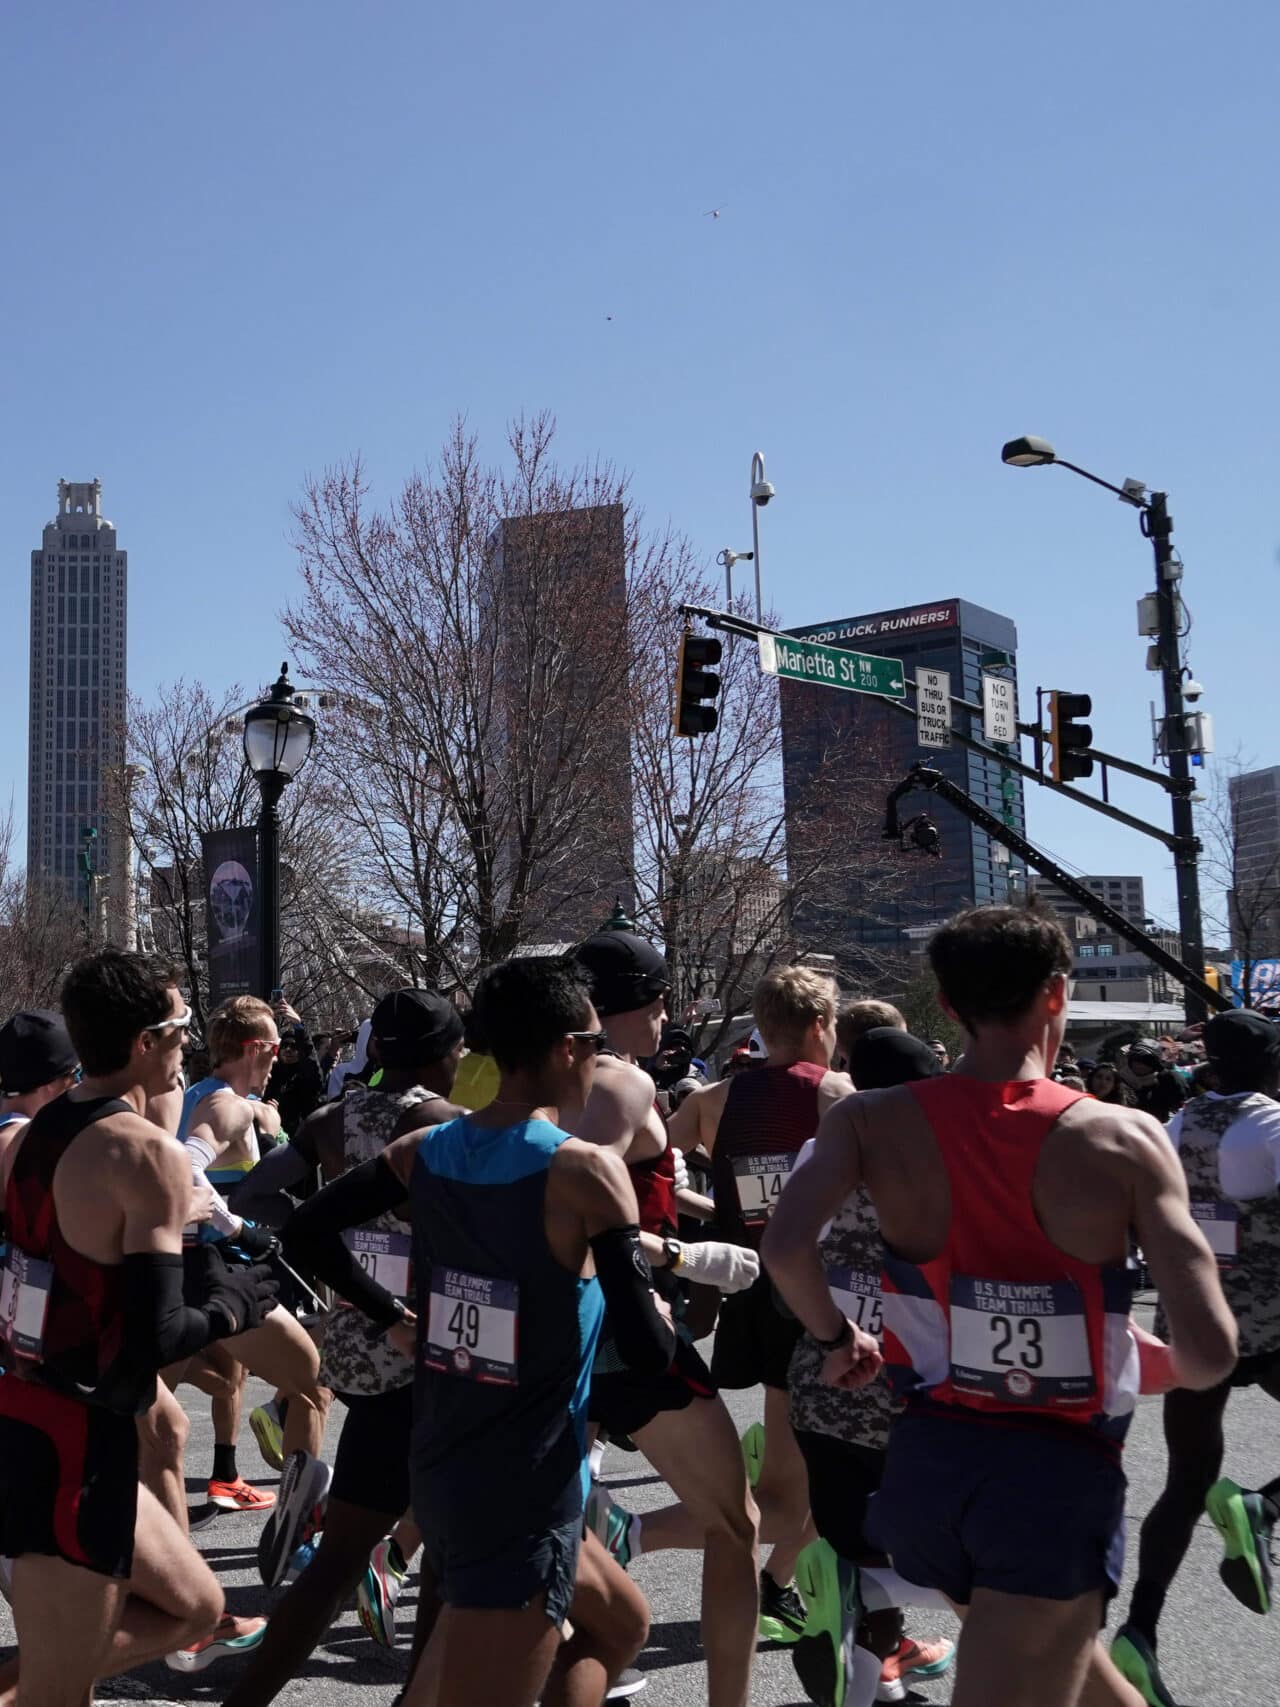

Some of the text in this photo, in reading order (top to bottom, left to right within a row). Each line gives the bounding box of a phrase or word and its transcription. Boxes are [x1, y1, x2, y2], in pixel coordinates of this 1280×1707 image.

[839, 623, 877, 640] LUCK,
[880, 609, 950, 632] RUNNERS!
[775, 643, 872, 682] Marietta St NW
[860, 674, 878, 687] 200
[927, 674, 938, 686] NO
[923, 688, 943, 700] THRU
[992, 683, 1007, 697] NO
[921, 702, 947, 716] BUS OR
[991, 698, 1008, 710] TURN
[922, 716, 946, 729] TRUCK
[995, 712, 1005, 723] ON
[920, 730, 950, 744] TRAFFIC
[993, 725, 1008, 737] RED
[761, 1154, 789, 1164] OLYMPIC
[749, 1163, 789, 1173] TEAM TRIALS
[757, 1174, 782, 1203] 14
[365, 1232, 390, 1243] OLYMPIC
[354, 1241, 389, 1253] TEAM TRIALS
[445, 1271, 493, 1292] U.S. OLYMPIC
[849, 1281, 872, 1295] TEAM
[444, 1283, 491, 1304] TEAM TRIALS
[974, 1280, 1053, 1299] U.S. OLYMPIC
[974, 1295, 1056, 1315] TEAM TRIALS
[448, 1302, 479, 1348] 49
[990, 1315, 1043, 1369] 23
